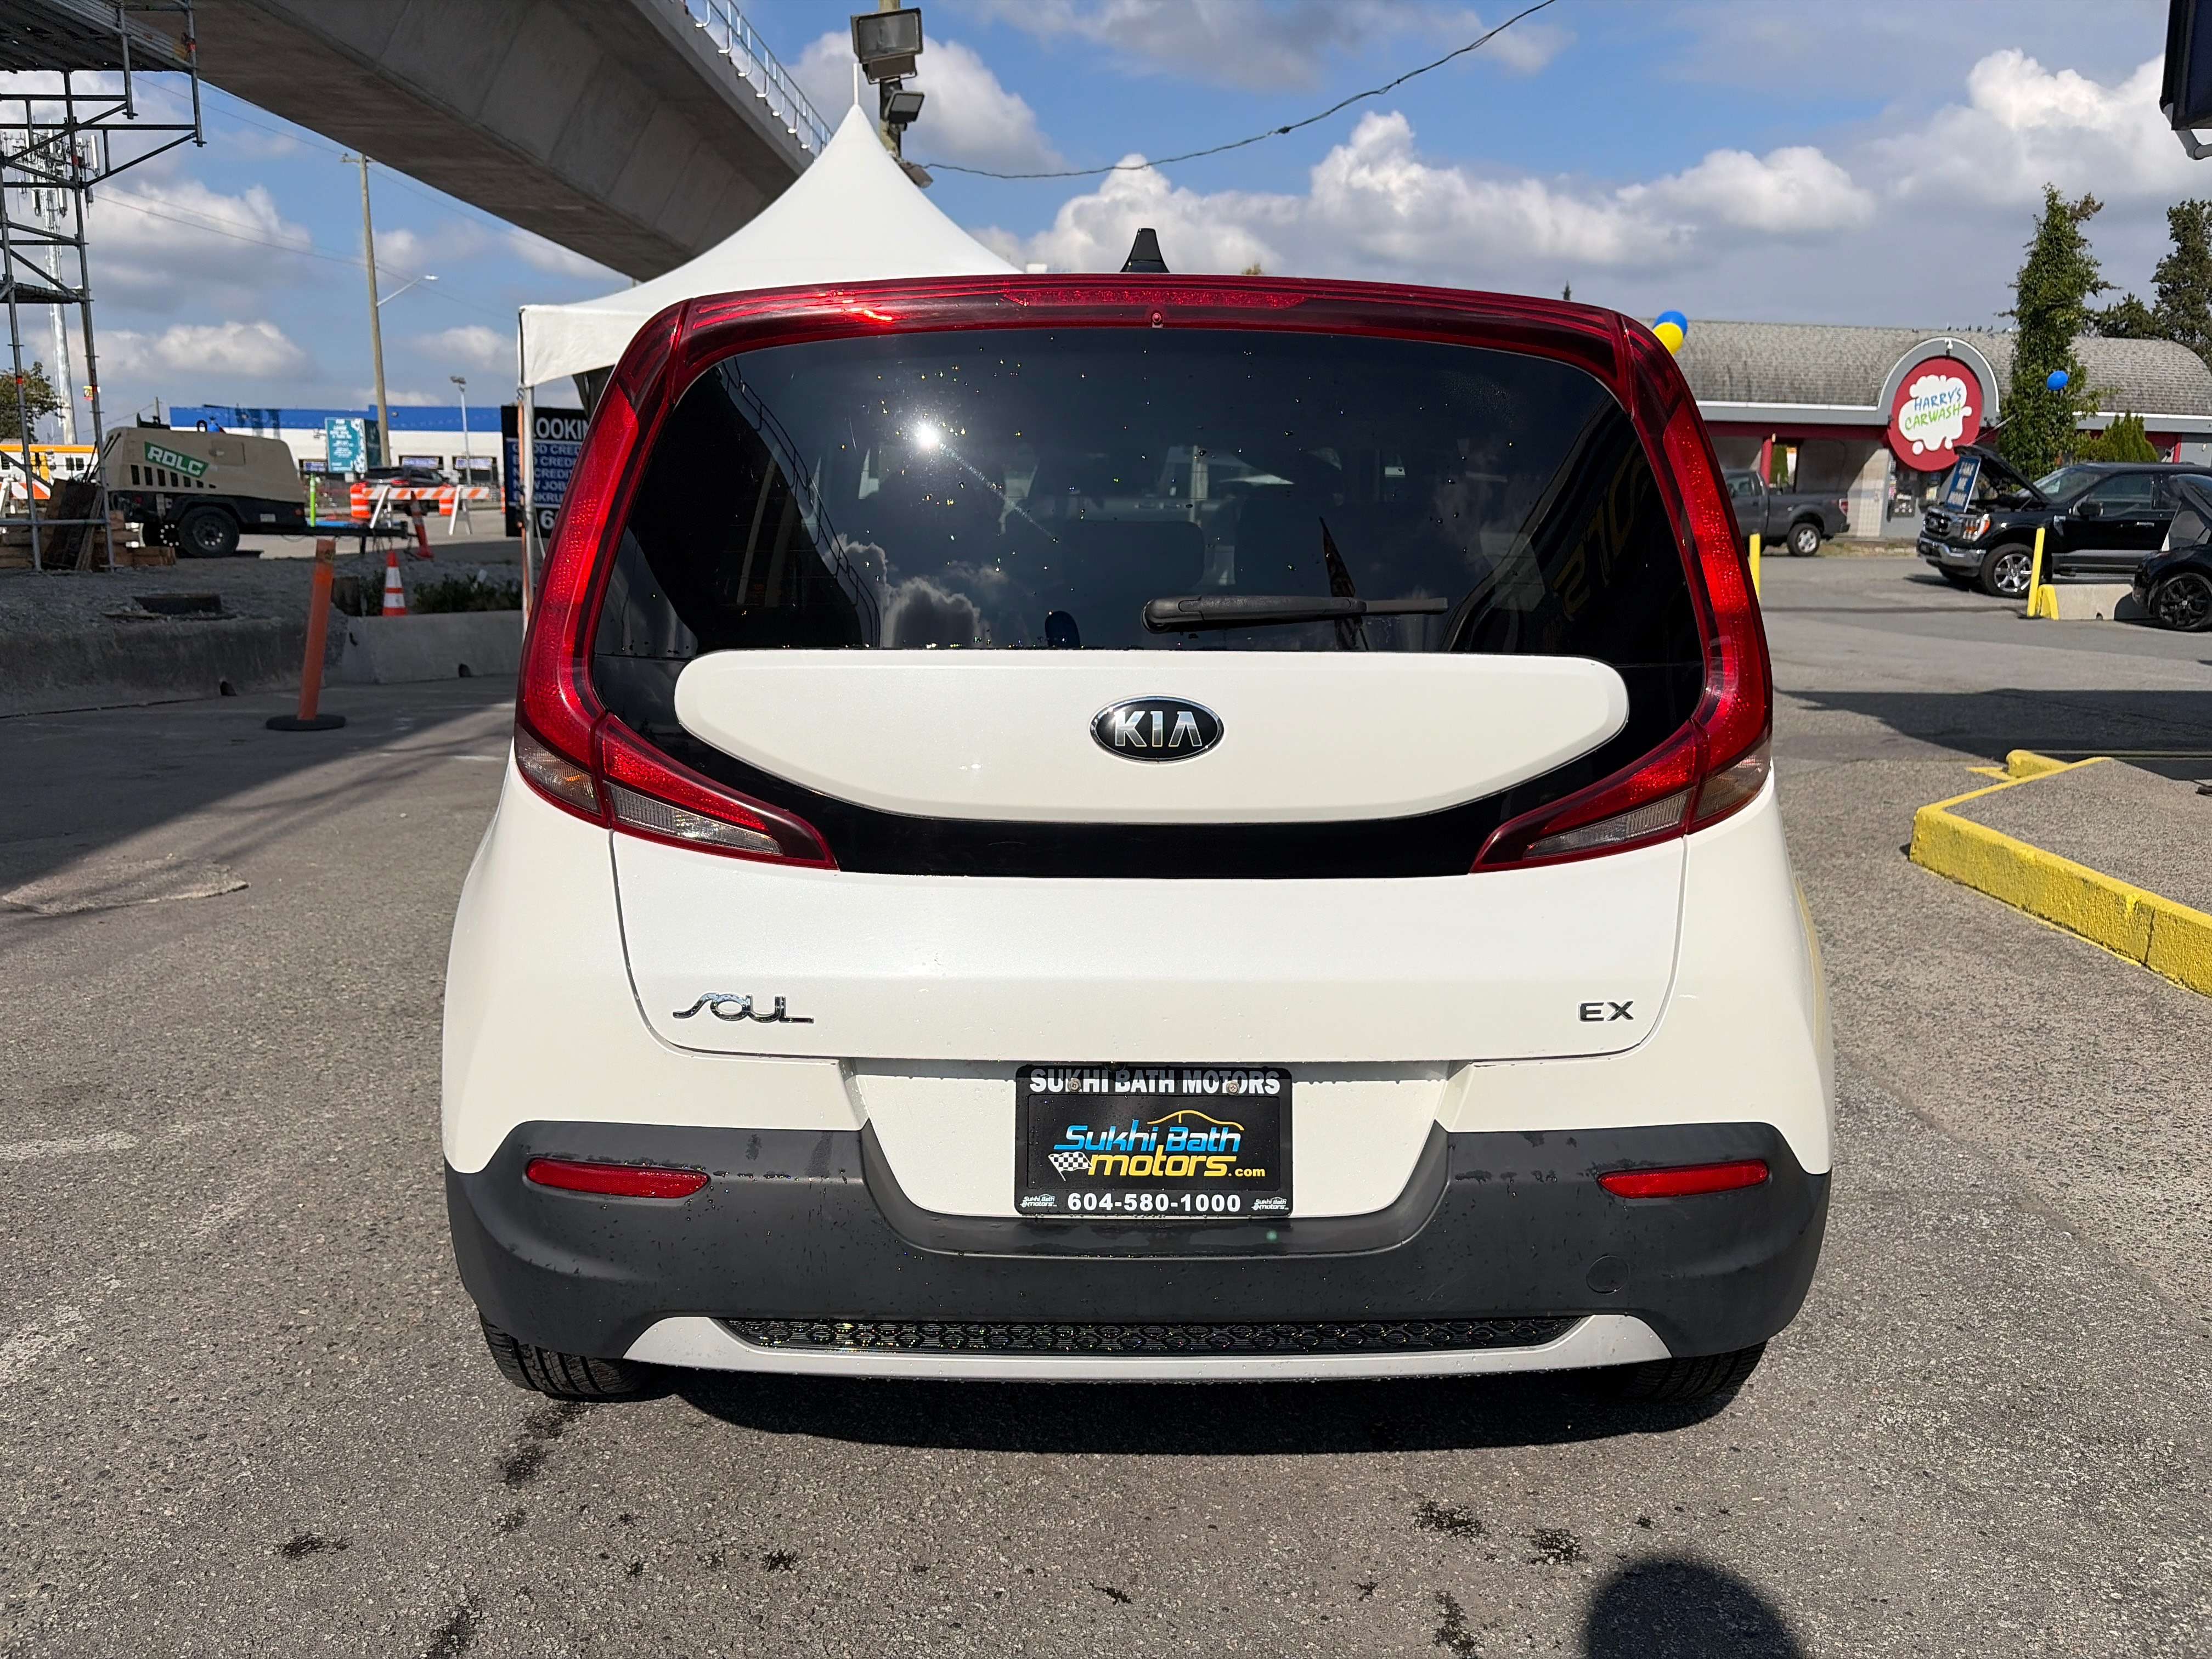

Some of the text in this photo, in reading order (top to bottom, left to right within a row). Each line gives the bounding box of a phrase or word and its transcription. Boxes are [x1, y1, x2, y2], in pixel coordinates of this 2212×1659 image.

[1914, 387, 1961, 411] HARRY'S
[1905, 403, 1961, 431] CARWASH
[1114, 710, 1203, 747] KIA
[1578, 1000, 1634, 1022] EX
[1030, 1068, 1280, 1094] SUKHI BATH MOTORS
[1053, 1119, 1242, 1152] Sukhi Bath
[1068, 1192, 1241, 1212] 604-580-1000
